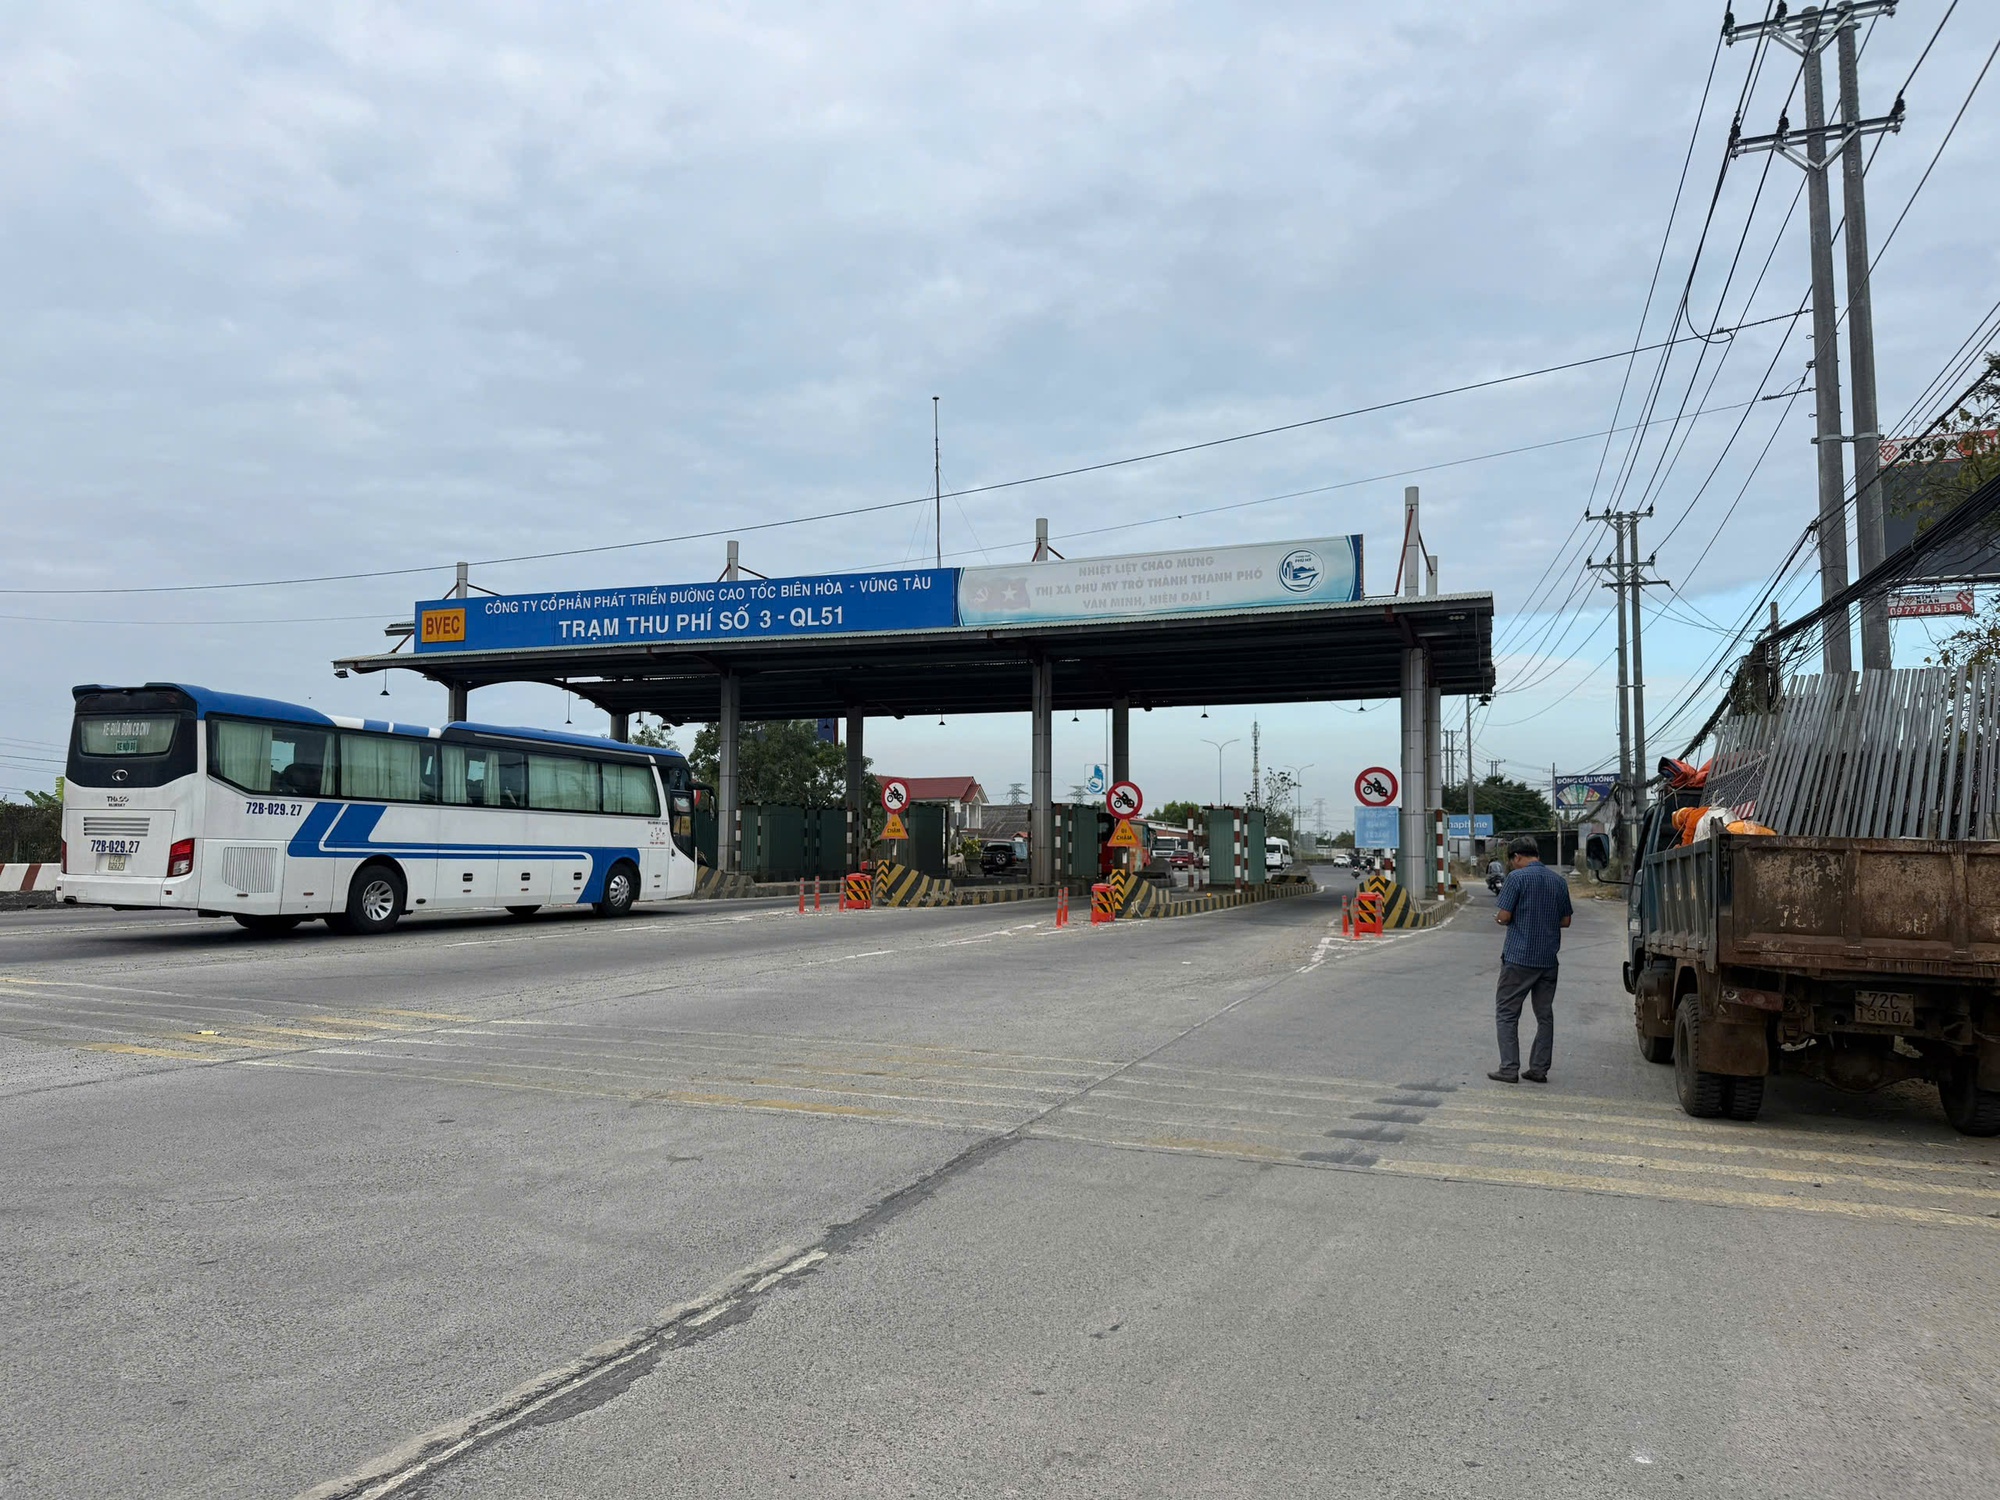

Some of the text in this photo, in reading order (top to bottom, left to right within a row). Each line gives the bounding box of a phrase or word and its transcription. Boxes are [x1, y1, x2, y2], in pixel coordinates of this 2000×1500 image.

[485, 600, 519, 615] CÔNG
[522, 601, 537, 612] TY
[540, 595, 557, 612] CỔ
[558, 592, 591, 611] PHẦN
[594, 592, 626, 608] PHÁT
[630, 587, 666, 606] TRIỂN
[670, 587, 715, 603] ĐƯỜNG
[719, 587, 745, 600] CAO
[750, 582, 776, 599] TỐC
[781, 581, 811, 597] BIÊN
[815, 579, 843, 595] HÒA
[859, 577, 898, 593] VŨNG
[903, 574, 931, 590] TÀU
[425, 615, 460, 635] BVEC
[558, 618, 619, 641] TRẠM
[626, 615, 669, 635] THU
[676, 607, 714, 632] PHÍ
[719, 603, 750, 631] SỐ
[759, 610, 772, 629] 3
[789, 606, 843, 628] QL51
[246, 802, 303, 817] 72B-029.27
[91, 839, 140, 854] 72B-029.27
[1868, 992, 1900, 1009] 72C
